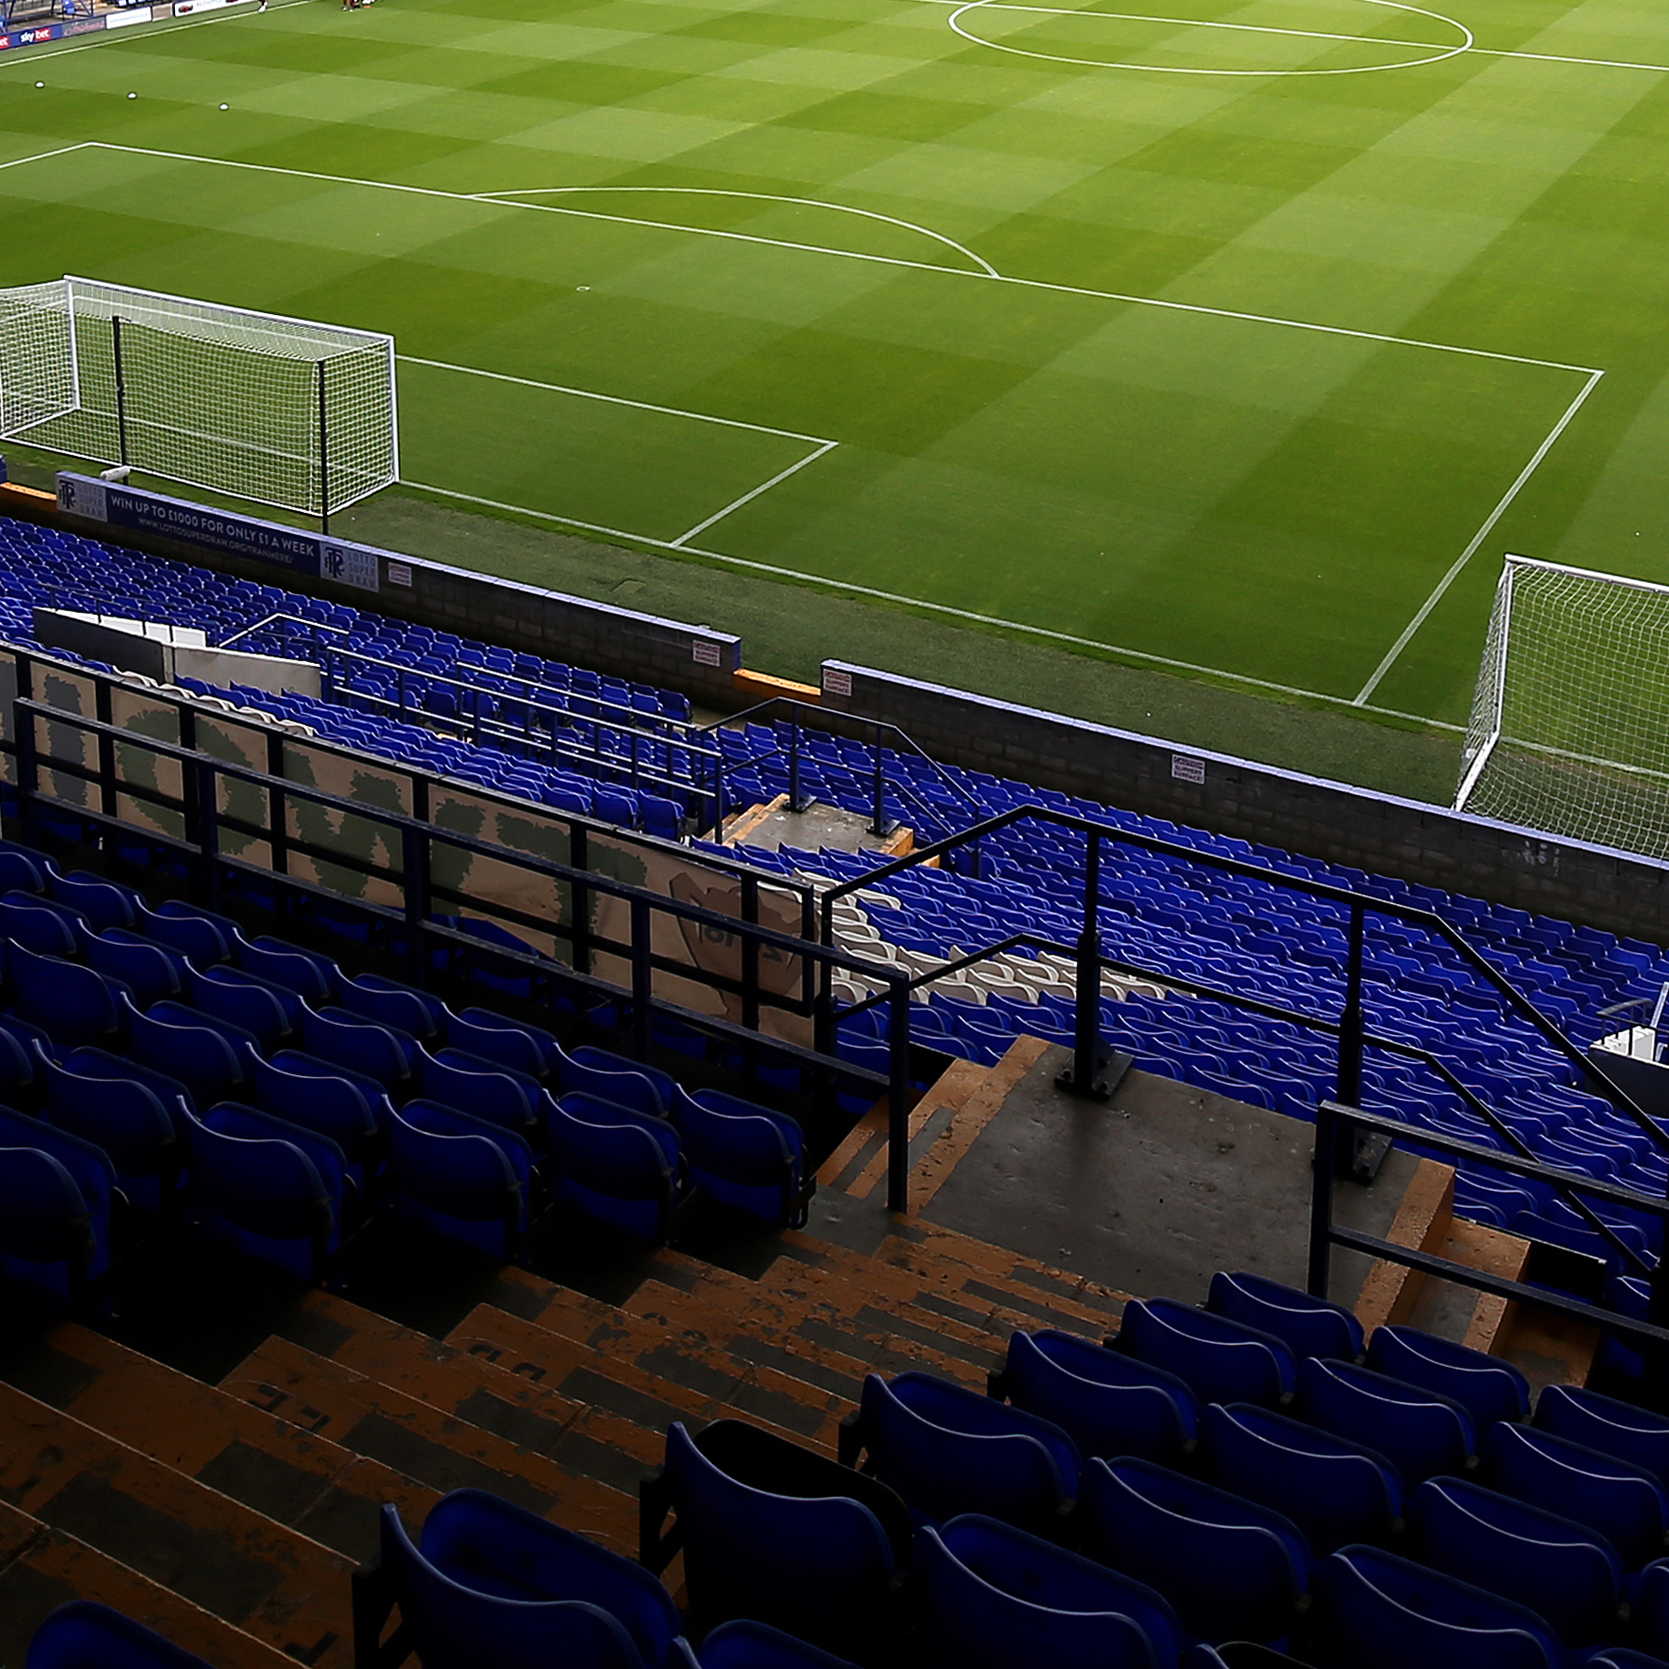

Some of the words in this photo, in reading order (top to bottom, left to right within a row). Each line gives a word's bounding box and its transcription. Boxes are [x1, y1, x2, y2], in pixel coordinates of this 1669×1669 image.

[20, 31, 35, 43] sky
[35, 28, 50, 39] bet
[110, 494, 133, 510] WIN
[135, 500, 150, 514] UP
[151, 504, 166, 519] TO
[167, 508, 199, 527] £1000
[201, 517, 224, 535] FOR
[226, 523, 257, 541] ONLY
[258, 531, 270, 544] £1
[270, 535, 280, 547] A
[280, 537, 314, 557] WEEK
